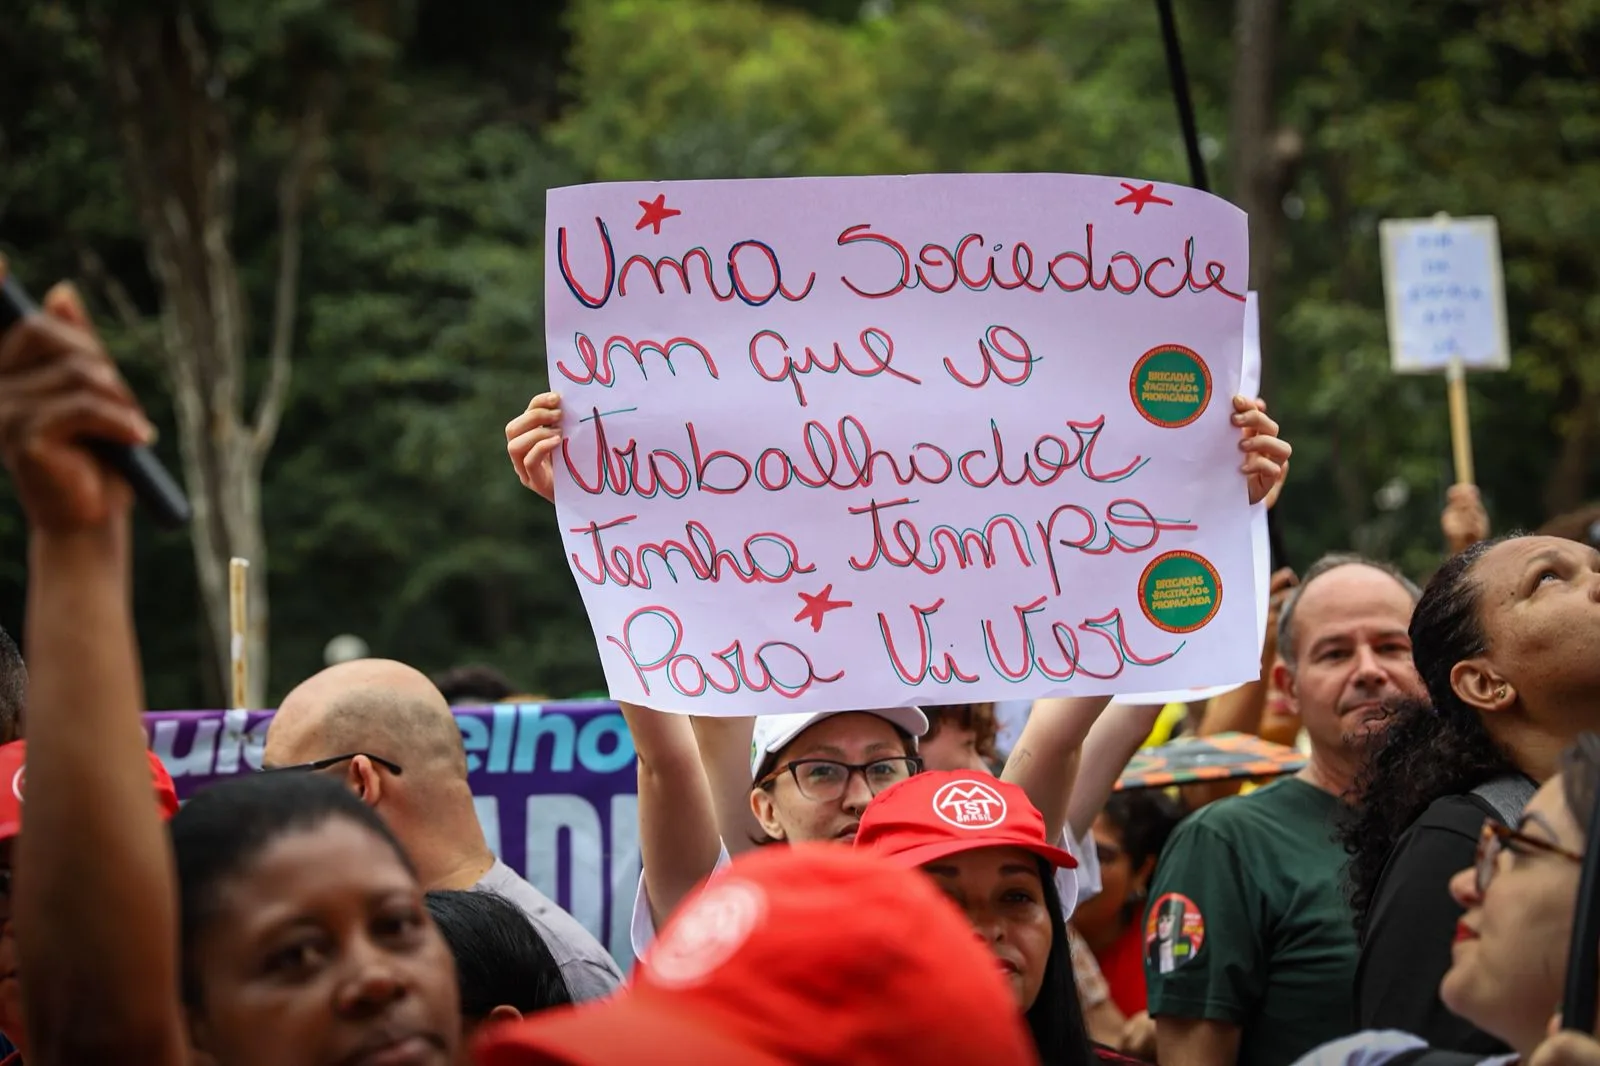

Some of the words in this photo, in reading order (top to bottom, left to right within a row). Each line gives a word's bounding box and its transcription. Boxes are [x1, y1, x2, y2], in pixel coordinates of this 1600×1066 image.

[557, 216, 816, 309] Uma
[556, 331, 719, 387] em
[749, 328, 922, 407] que
[1148, 371, 1196, 382] BRIGADAS
[1141, 392, 1200, 403] PROPAGANDA
[1156, 576, 1204, 589] BRIGADAS
[1151, 596, 1211, 610] PROPAGANDA
